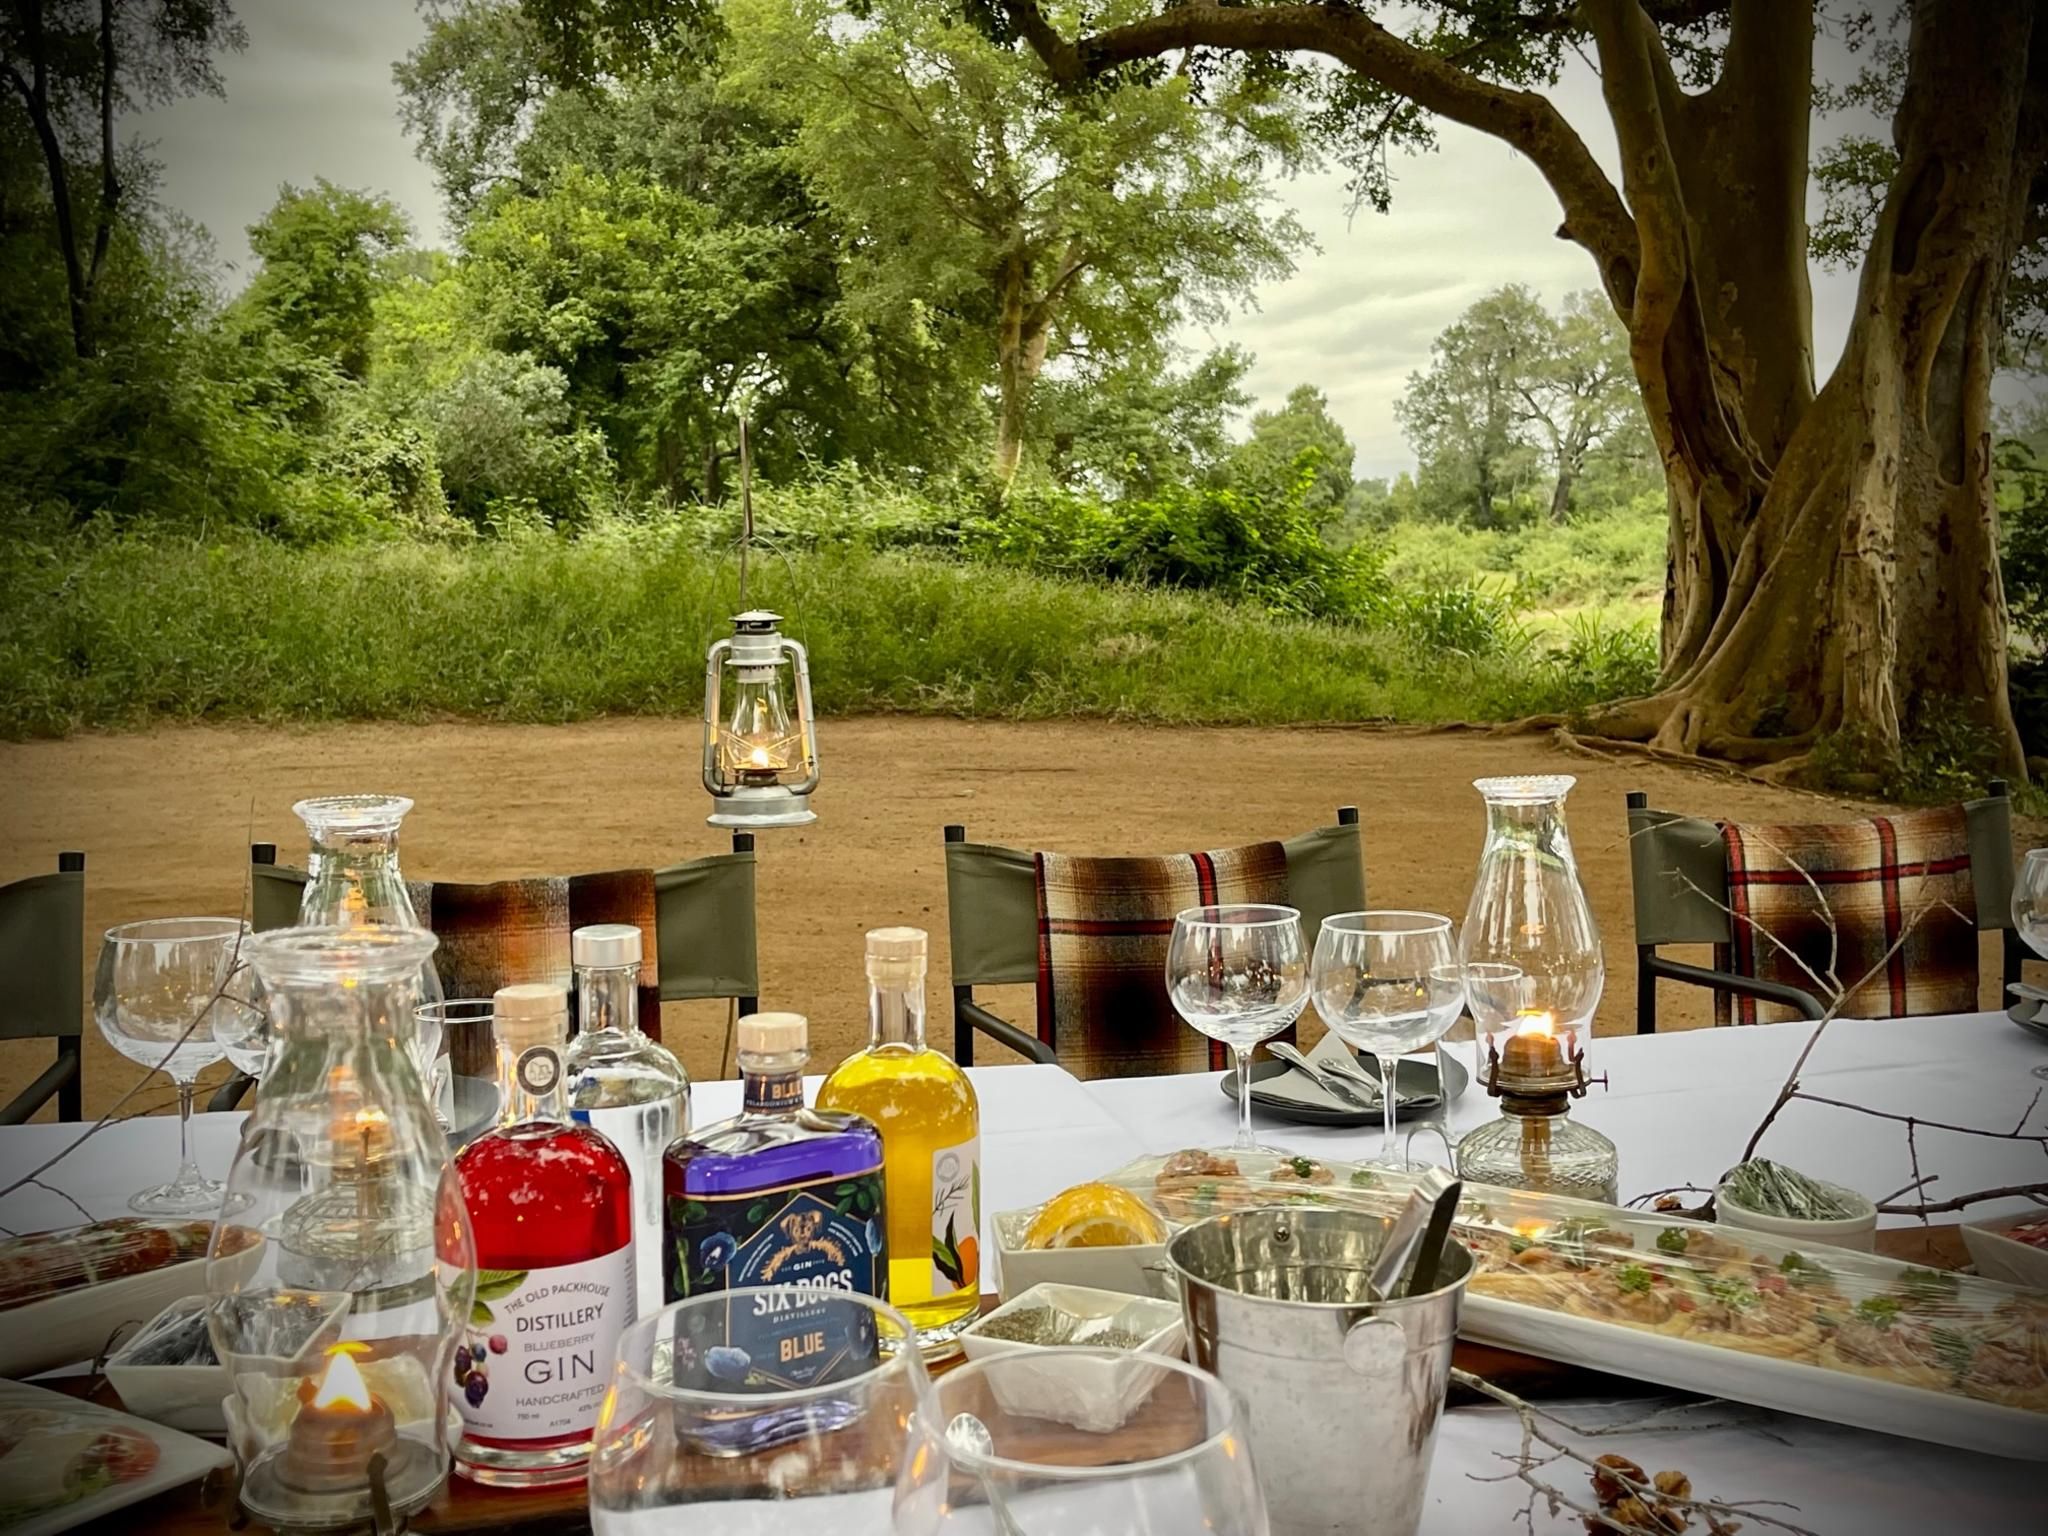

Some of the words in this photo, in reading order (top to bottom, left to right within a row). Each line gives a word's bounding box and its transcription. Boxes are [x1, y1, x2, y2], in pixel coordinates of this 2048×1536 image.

[793, 1260, 812, 1271] GIN
[504, 1297, 525, 1314] THE
[525, 1286, 549, 1303] OLD
[552, 1282, 611, 1297] PACKHOUSE
[753, 1281, 791, 1315] SIX
[796, 1268, 853, 1308] DOGS
[516, 1302, 604, 1332] DISTILLERY
[773, 1307, 826, 1324] DISTILLERY
[524, 1332, 595, 1352] BLUEBERRY
[780, 1331, 825, 1363] BLUE
[524, 1349, 594, 1384] GIN
[515, 1383, 605, 1407] HANDCRAFTED
